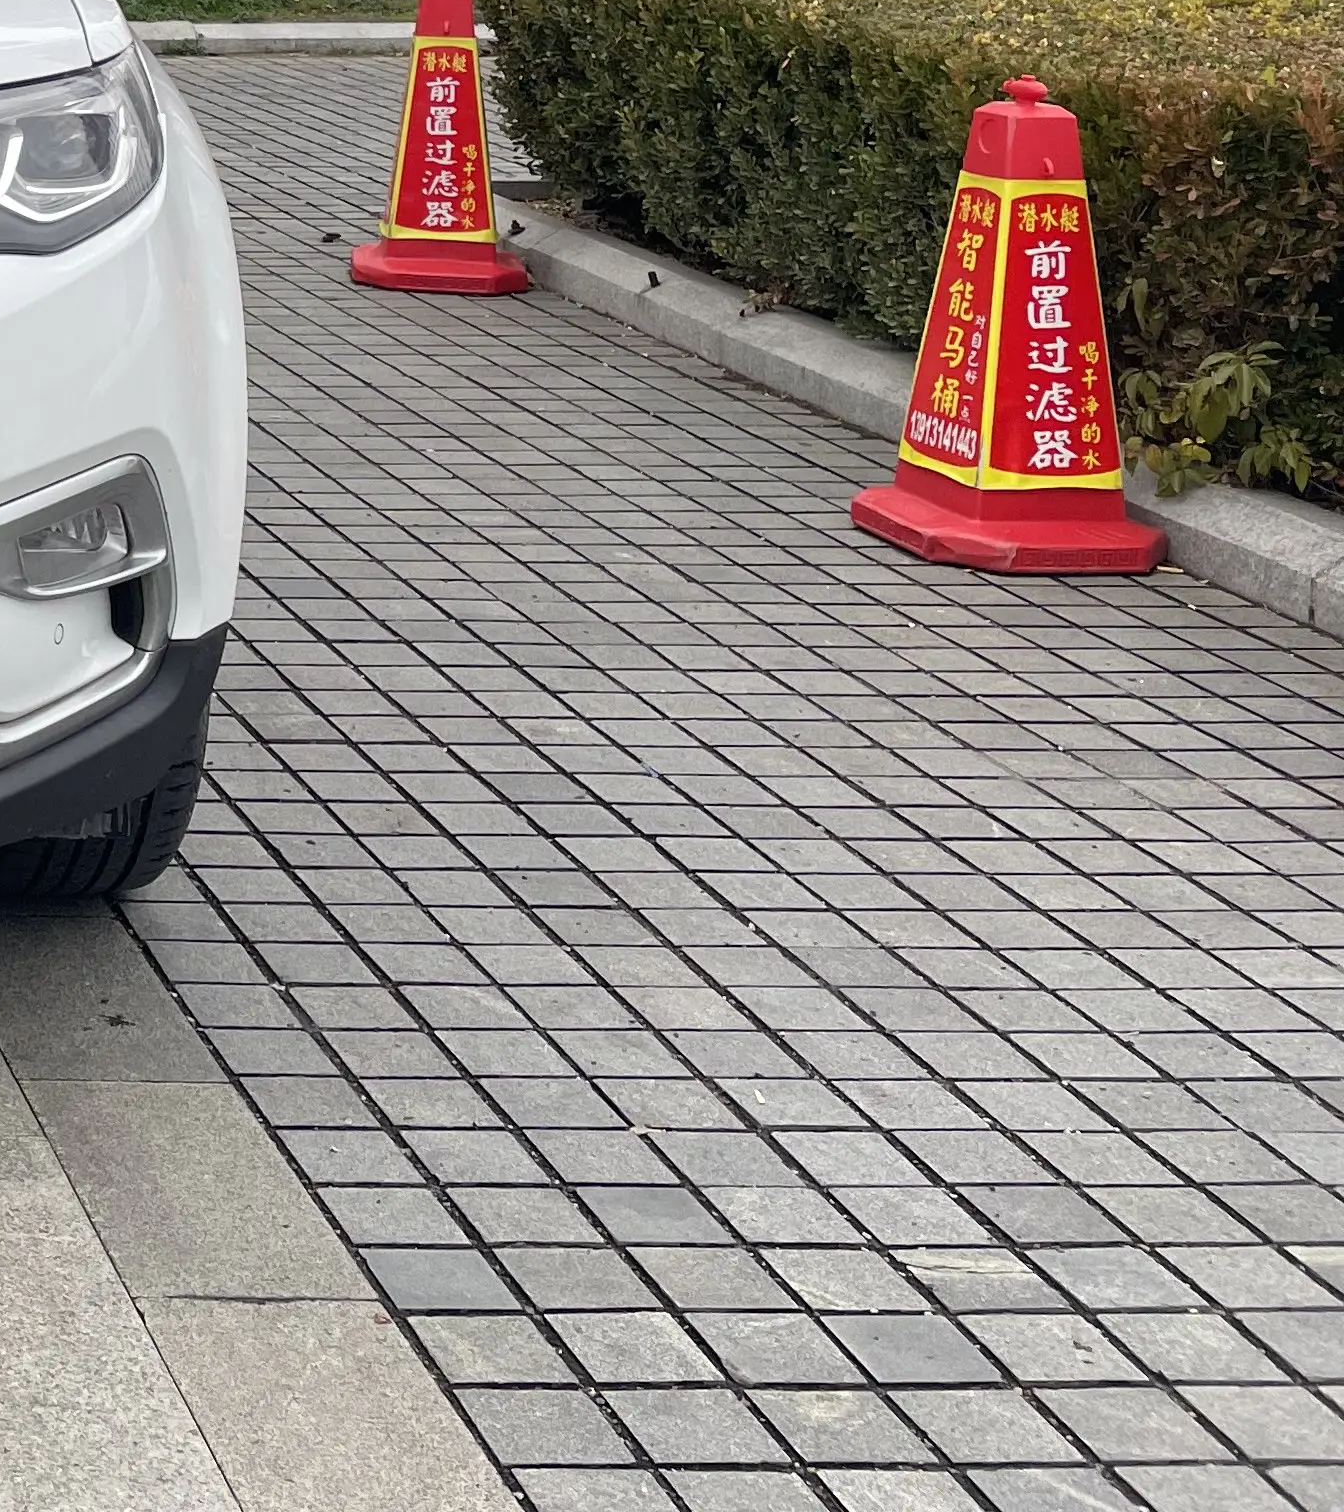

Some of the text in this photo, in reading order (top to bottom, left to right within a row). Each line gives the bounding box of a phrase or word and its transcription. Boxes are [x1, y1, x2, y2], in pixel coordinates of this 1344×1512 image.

[422, 51, 468, 74] 潜水艇
[420, 76, 461, 228] 前置过滤器
[1017, 202, 1080, 235] 潜水艇
[930, 228, 984, 420] 智能马桶
[1023, 238, 1079, 472] 前置过滤器
[909, 409, 978, 462] 13913141443
[1078, 341, 1102, 471] 喝干净的水
